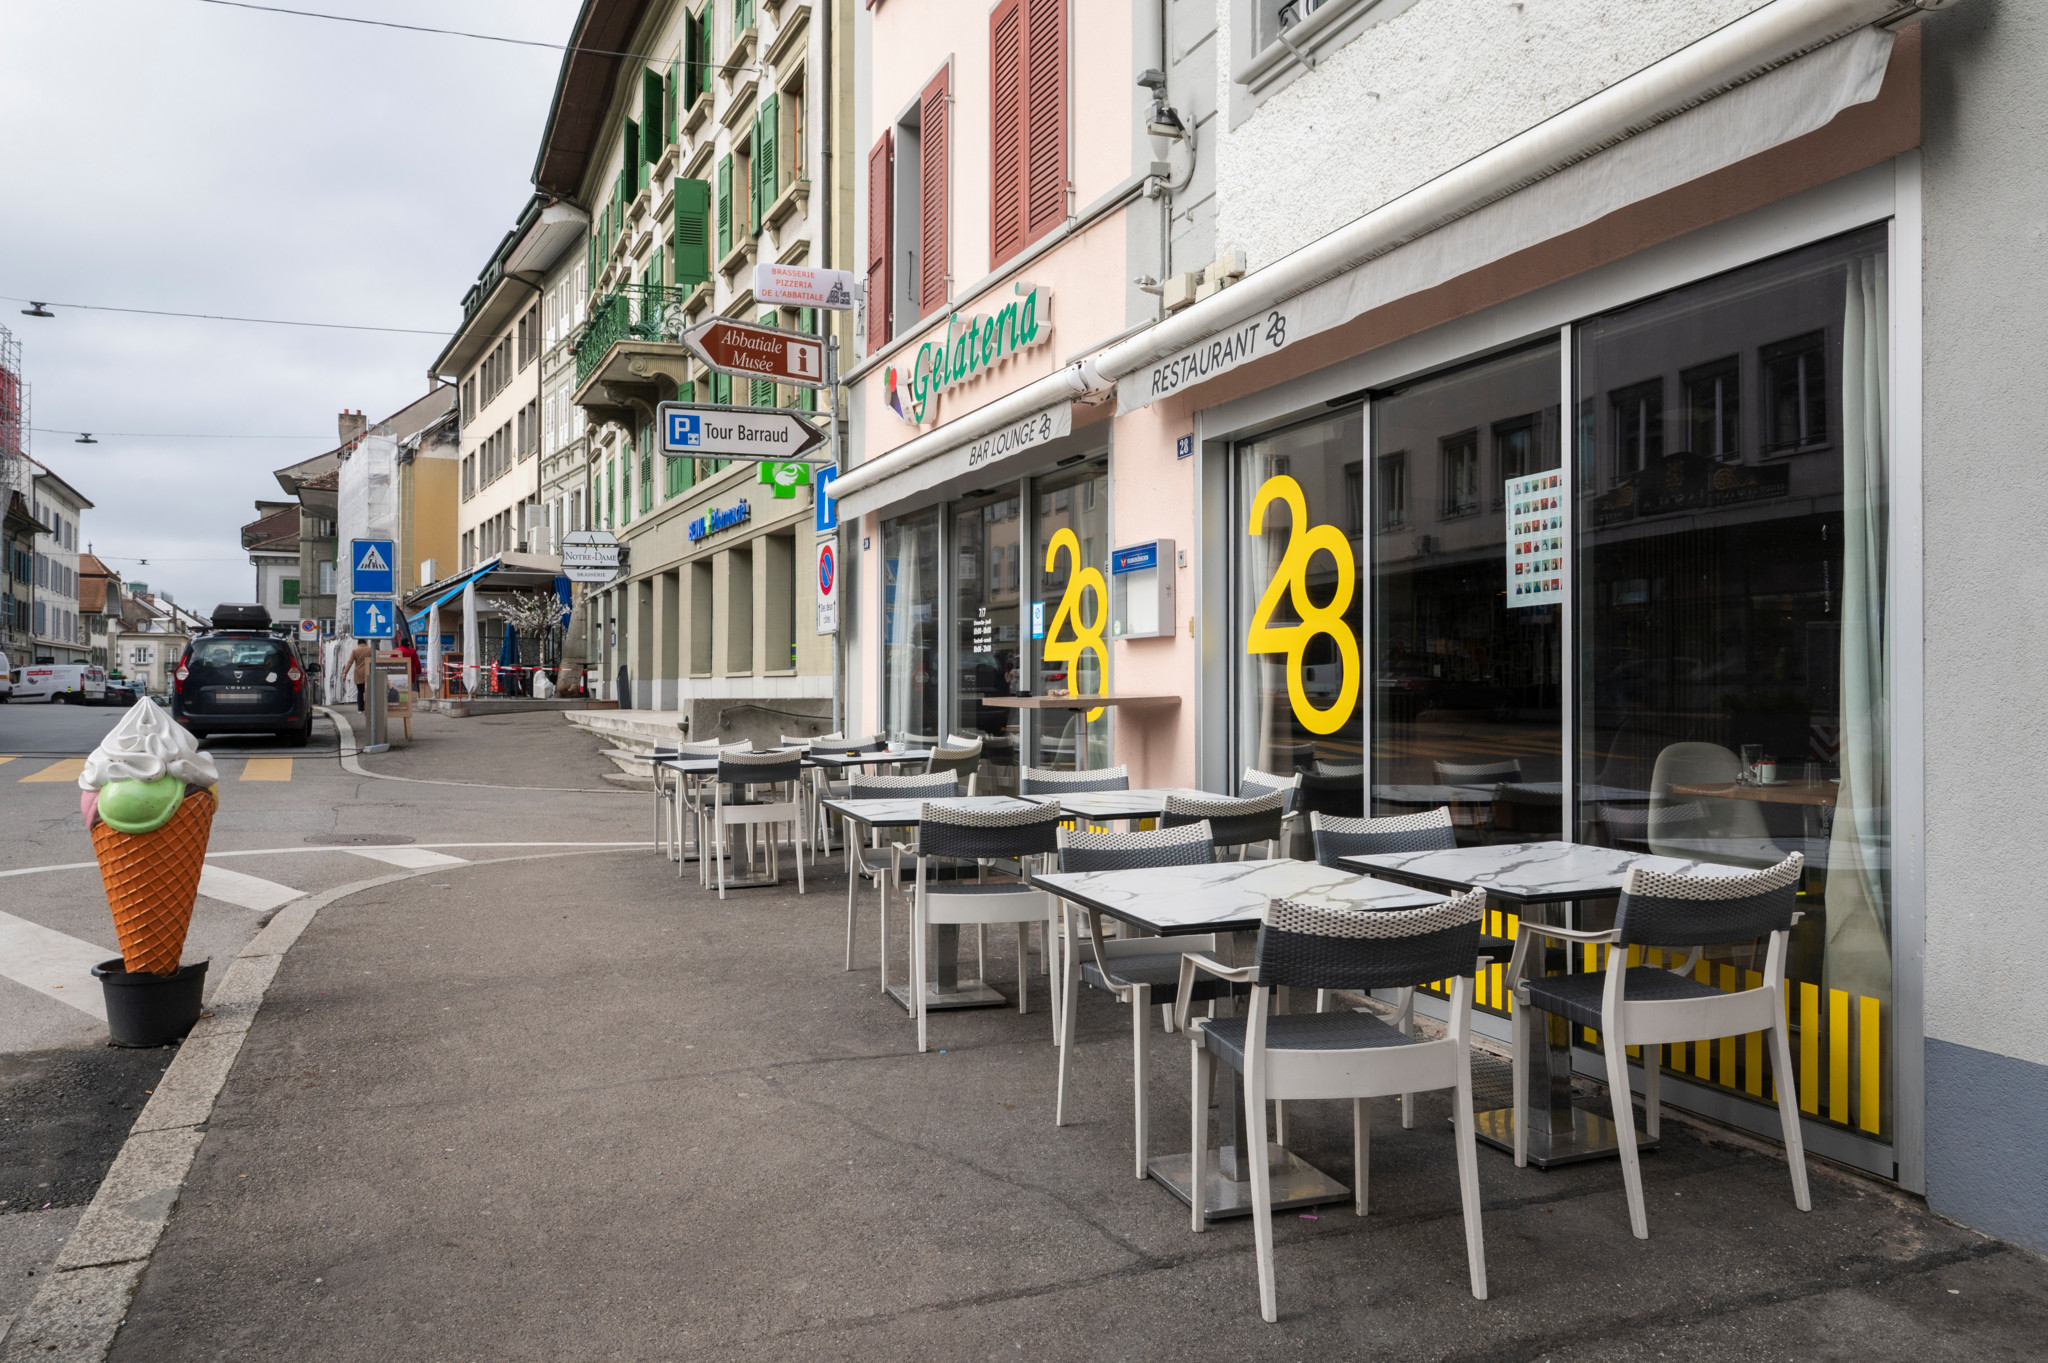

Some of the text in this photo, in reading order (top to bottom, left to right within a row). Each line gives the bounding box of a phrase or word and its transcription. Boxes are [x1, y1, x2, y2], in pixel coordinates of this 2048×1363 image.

[771, 267, 816, 279] BRASSERIE
[775, 279, 813, 289] PIZZERIA
[761, 289, 824, 302] DE L'ABBATIALE
[720, 330, 783, 354] Abbatiale
[912, 280, 1040, 424] Gelateria
[731, 350, 774, 372] Musée
[1151, 310, 1287, 397] RESTAURANT 28
[704, 422, 789, 443] Tour Barraud
[968, 412, 1052, 467] BAR LOUNGE 28
[1178, 436, 1190, 457] 28
[565, 551, 617, 562] NOTRE-DAME
[1246, 474, 1361, 735] 28
[1043, 527, 1109, 723] 28
